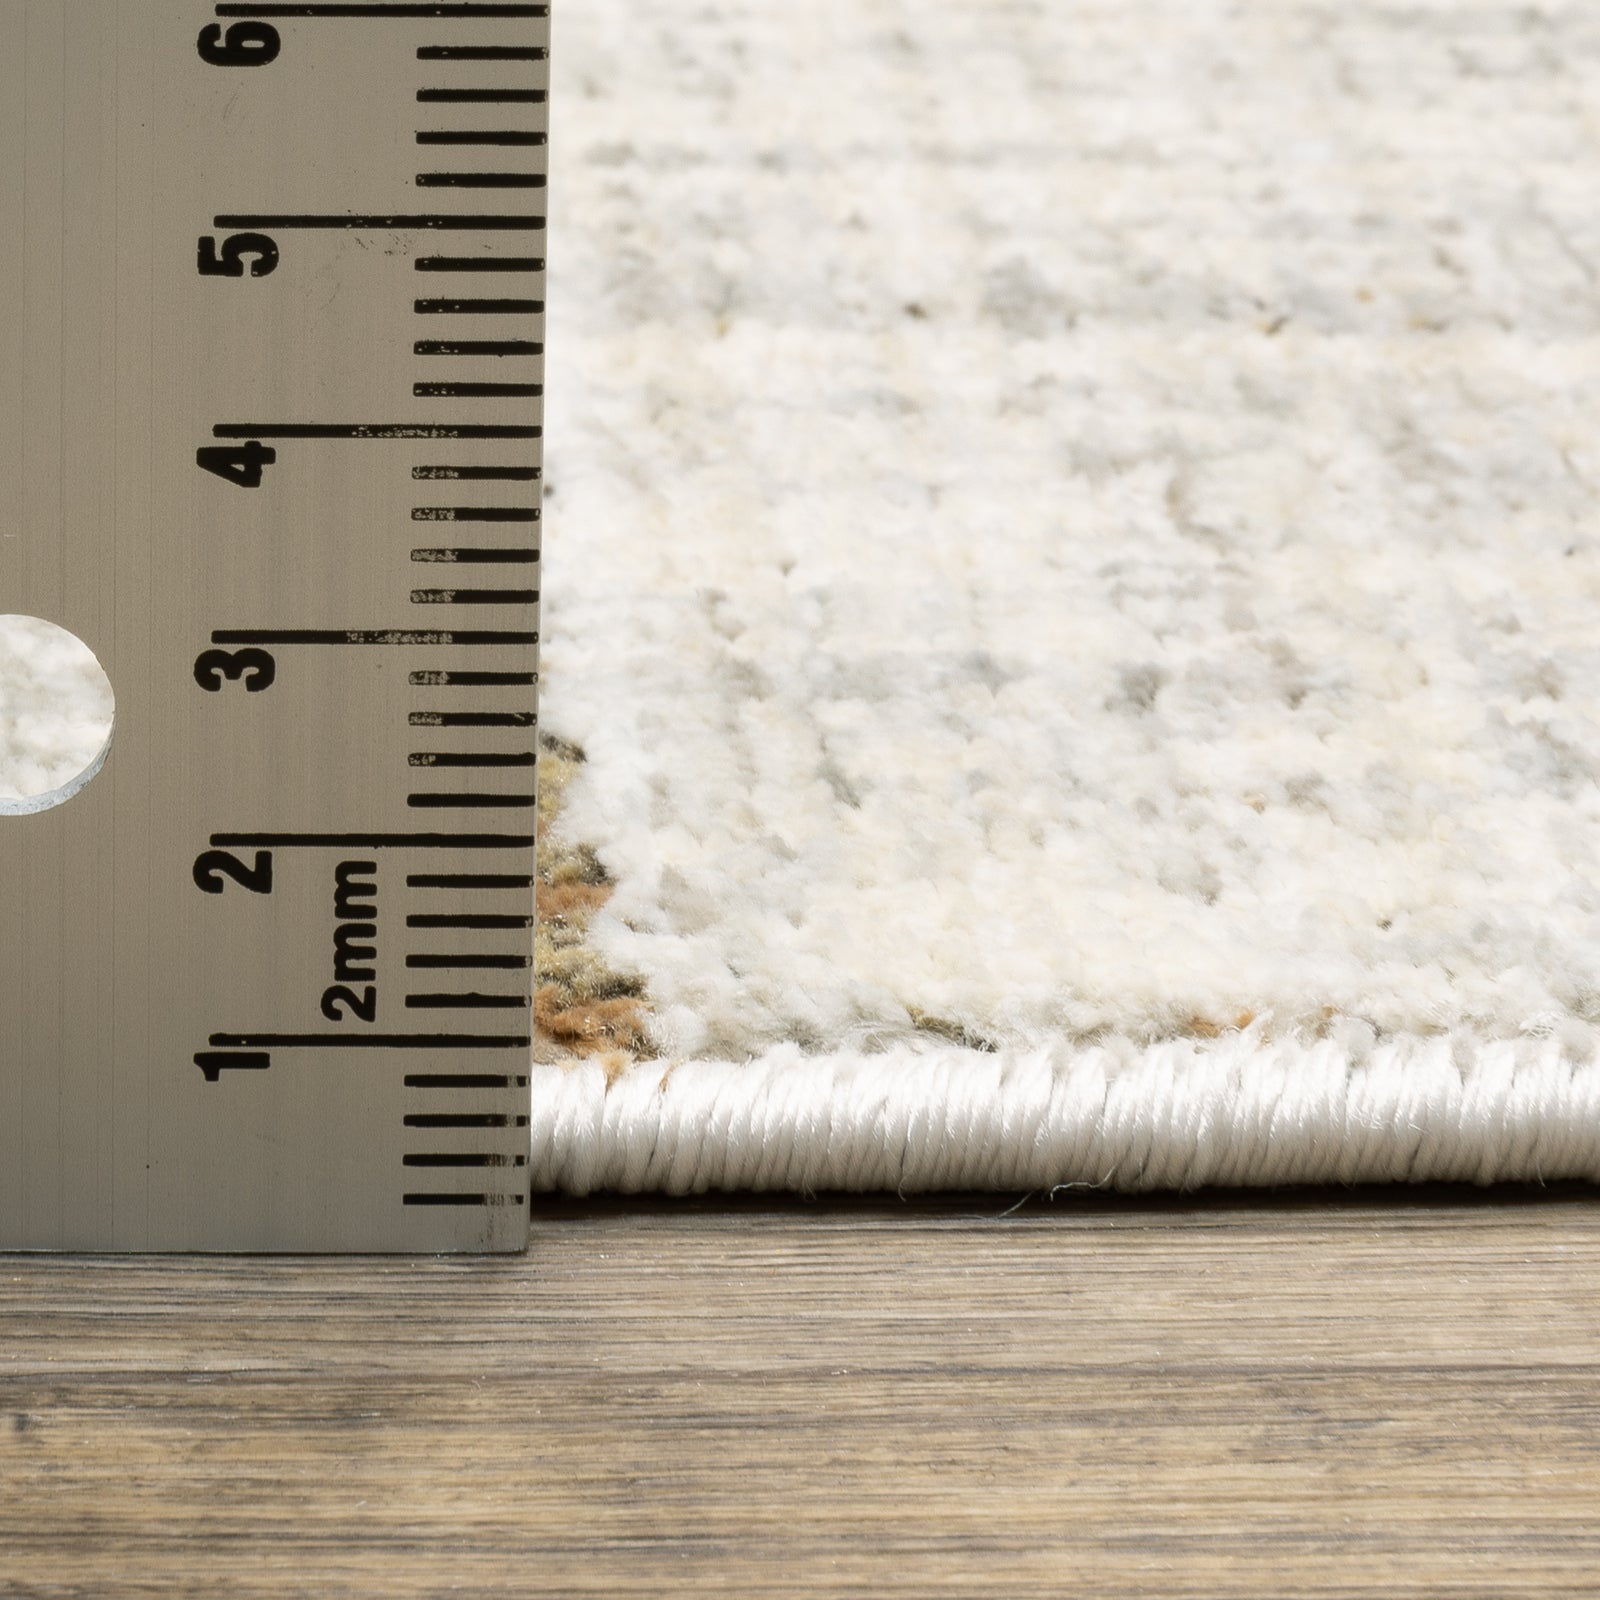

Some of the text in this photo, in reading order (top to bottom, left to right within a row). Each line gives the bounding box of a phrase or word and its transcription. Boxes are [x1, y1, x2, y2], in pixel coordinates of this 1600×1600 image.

[195, 19, 282, 69] 6
[195, 231, 281, 279] 5
[195, 439, 278, 489] 4
[192, 646, 277, 694] 3
[191, 848, 274, 896] 2
[319, 859, 379, 1024] 2mm
[191, 1050, 272, 1084] 1
